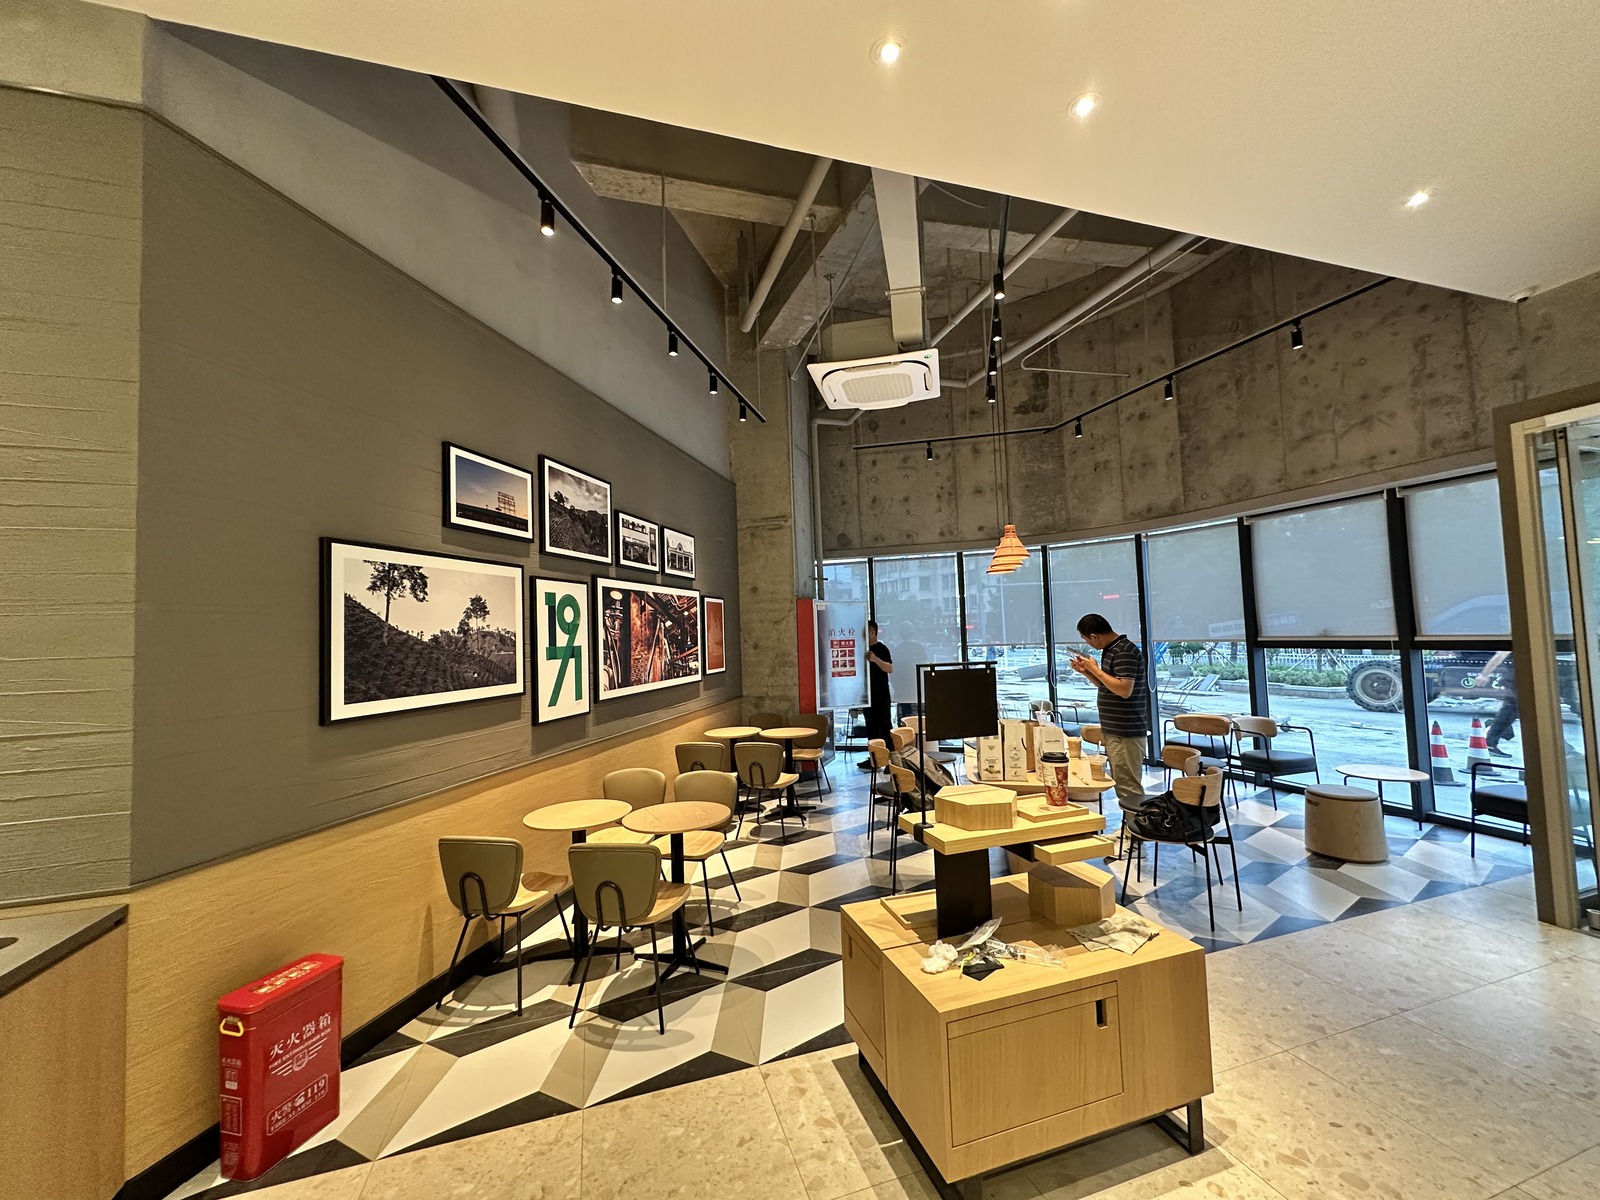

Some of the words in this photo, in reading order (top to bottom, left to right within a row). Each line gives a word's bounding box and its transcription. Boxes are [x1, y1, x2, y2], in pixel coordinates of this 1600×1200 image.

[828, 627, 856, 636] 消火栓
[270, 1011, 331, 1062] 灭火器箱
[307, 1079, 325, 1099] 119
